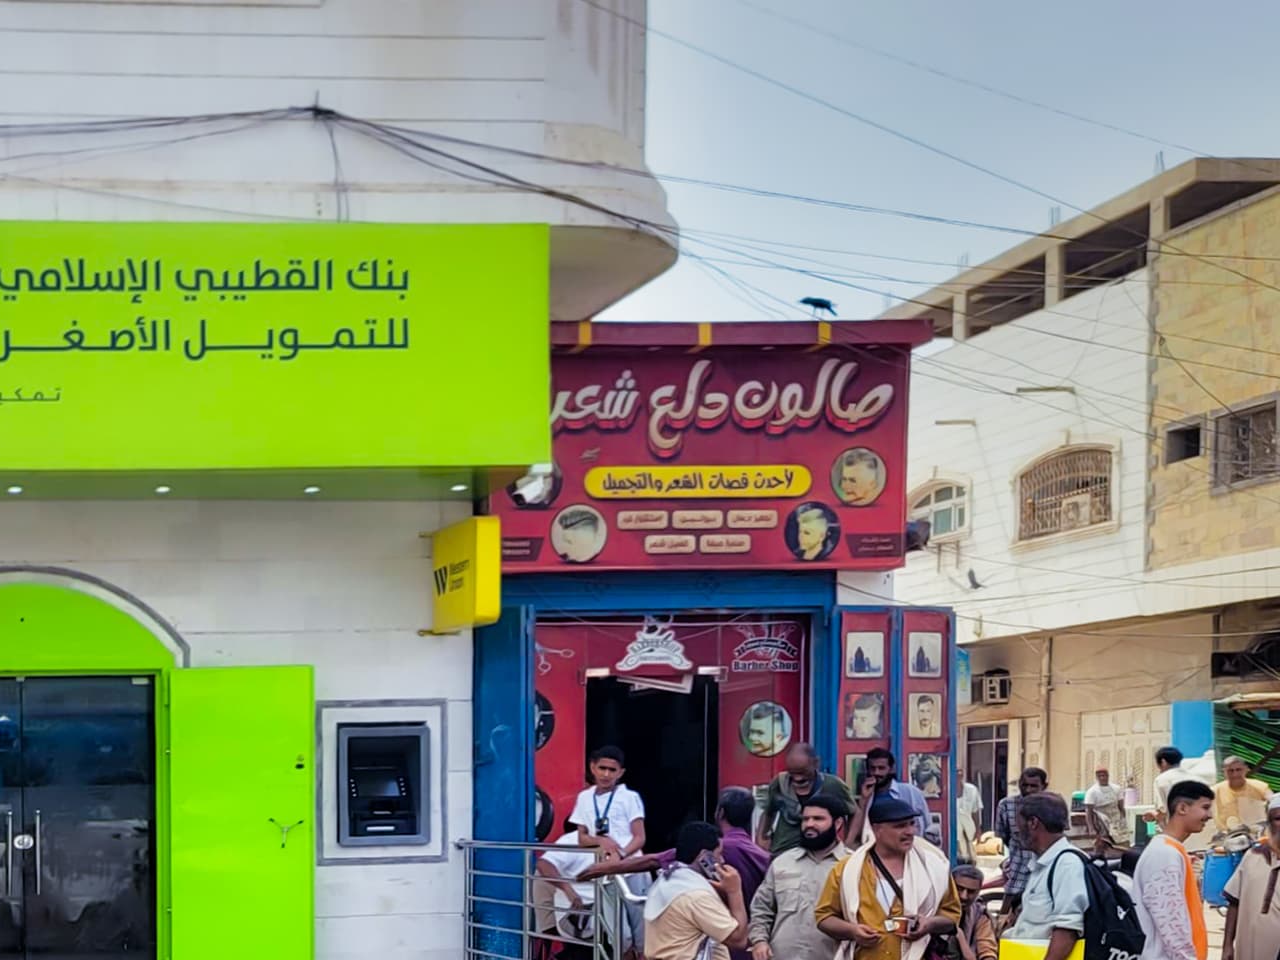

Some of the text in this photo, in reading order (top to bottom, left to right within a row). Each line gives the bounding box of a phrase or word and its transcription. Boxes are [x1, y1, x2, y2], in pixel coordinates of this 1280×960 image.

[175, 259, 333, 303] القطيبي
[346, 259, 410, 300] بنك
[183, 318, 410, 362] للتمويل
[649, 359, 730, 450] دلع
[735, 358, 895, 428] صالون
[602, 471, 662, 495] والتجميل
[665, 471, 704, 493] الشعر
[708, 471, 749, 490] قصات
[733, 661, 799, 671] Barber Shop
